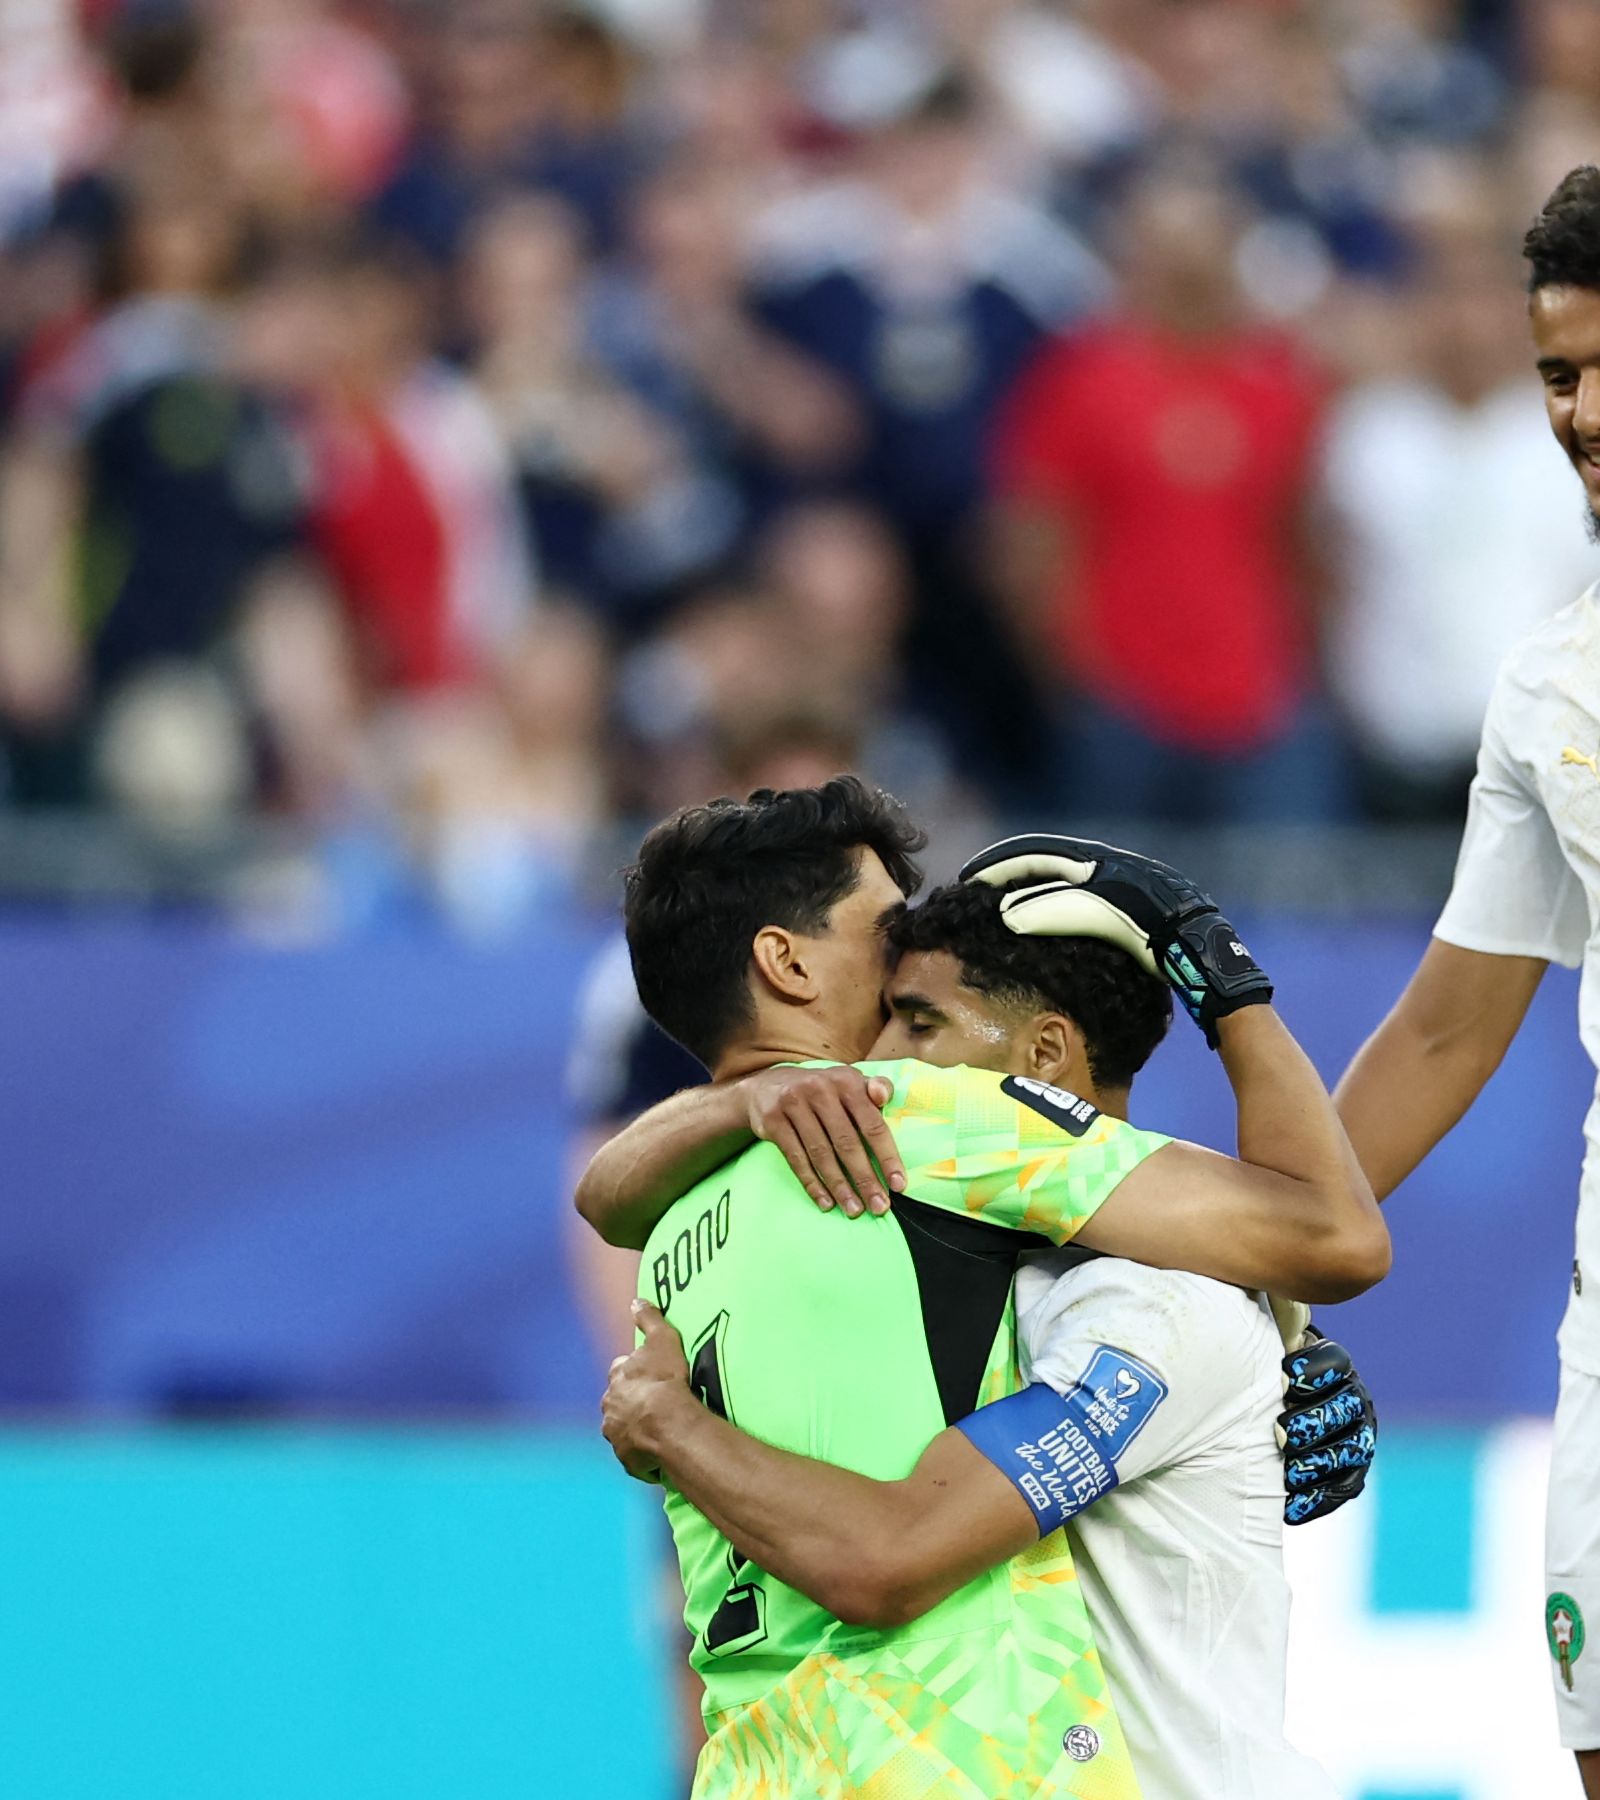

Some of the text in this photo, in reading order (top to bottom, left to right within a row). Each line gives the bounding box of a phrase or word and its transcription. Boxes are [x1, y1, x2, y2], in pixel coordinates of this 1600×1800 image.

[653, 1189, 732, 1316] BONO
[1056, 1418, 1112, 1492] FOOTBALL
[1083, 1418, 1102, 1439] FIFA
[1085, 1401, 1120, 1437] PEACE
[1015, 1441, 1078, 1521] the World
[1020, 1475, 1050, 1509] FIFA
[1038, 1429, 1098, 1505] UNITES
